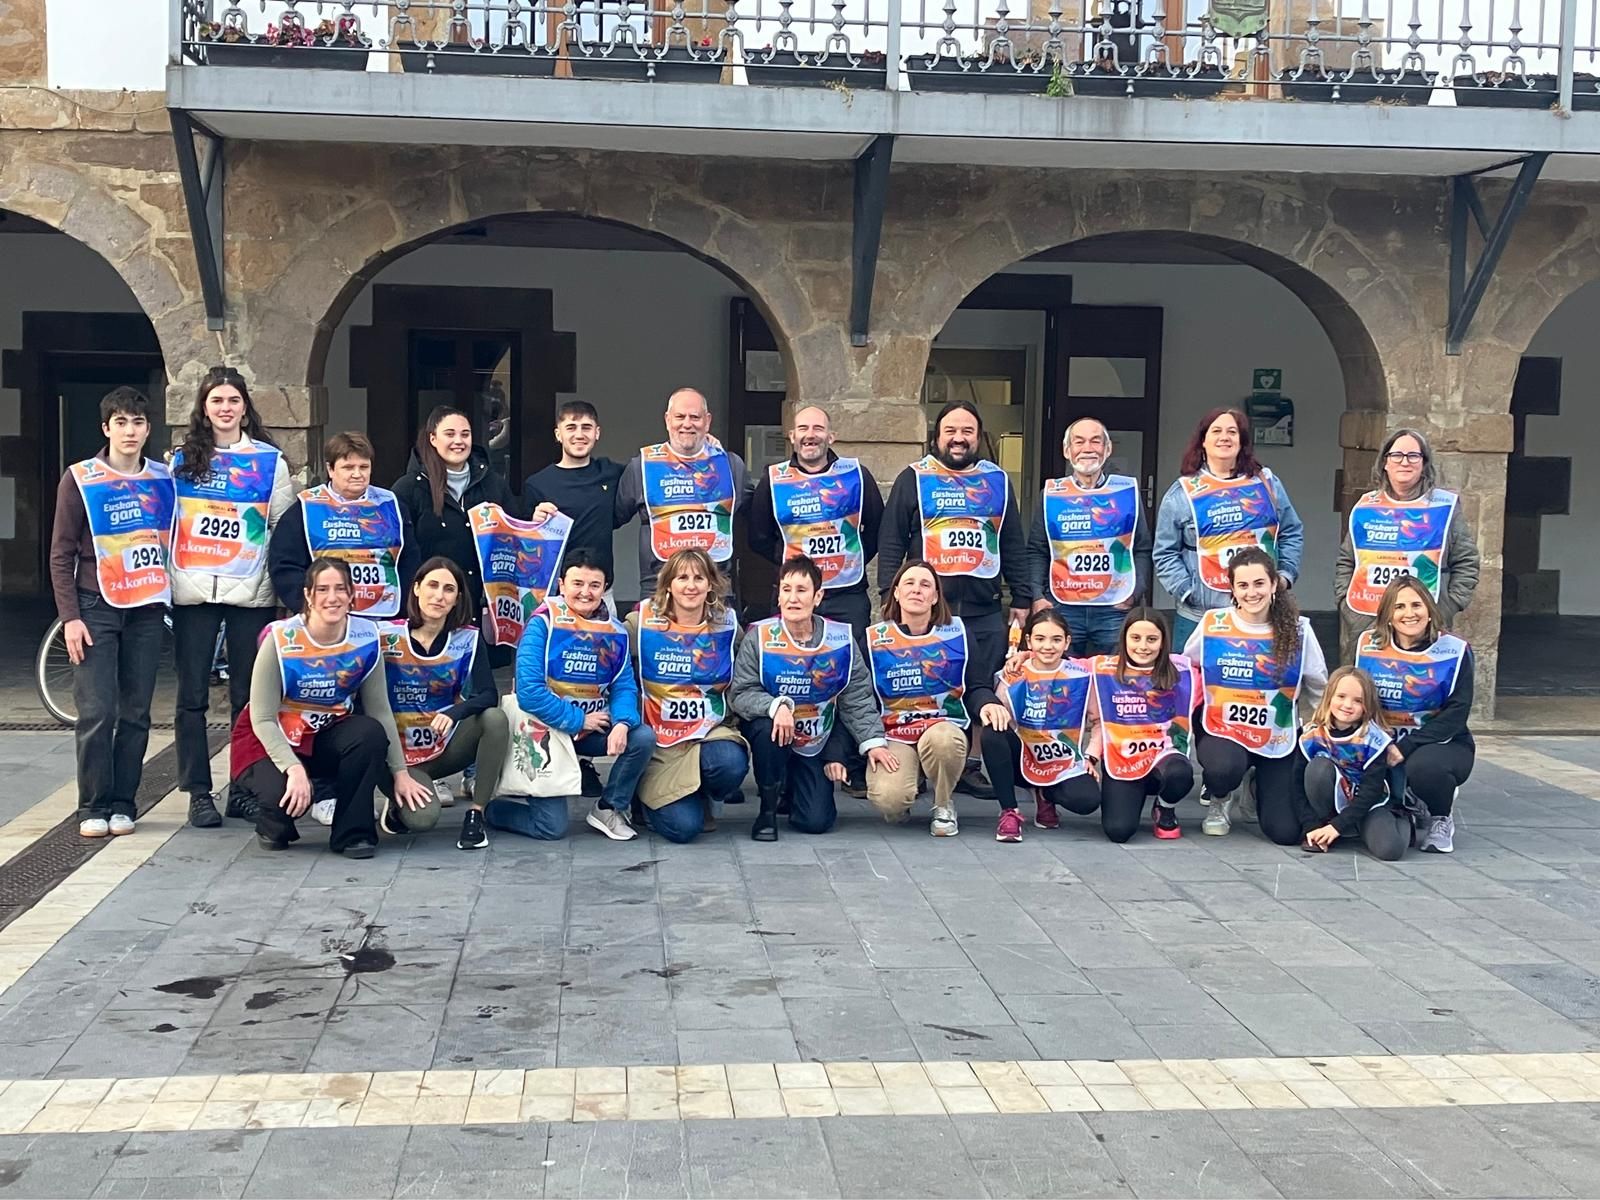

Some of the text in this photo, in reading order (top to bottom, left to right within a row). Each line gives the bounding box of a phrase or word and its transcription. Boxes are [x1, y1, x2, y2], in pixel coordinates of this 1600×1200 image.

[660, 478, 694, 487] Euskara
[664, 485, 694, 498] gara
[932, 491, 965, 499] Euskara
[103, 500, 140, 512] Euskara
[787, 496, 820, 507] Euskara
[936, 497, 966, 510] gara
[110, 508, 142, 525] gara
[792, 504, 821, 517] gara
[1057, 513, 1091, 521] Euskara
[1207, 506, 1241, 517] Euskara
[322, 520, 359, 529] Euskara
[678, 514, 712, 531] 2927
[1061, 520, 1091, 533] gara
[1213, 513, 1243, 527] gara
[1363, 522, 1399, 531] Euskara
[200, 517, 240, 539] 2929
[328, 528, 361, 541] gara
[949, 531, 983, 549] 2932
[1366, 530, 1398, 542] gara
[809, 536, 841, 555] 2927
[492, 561, 516, 574] gara
[1074, 554, 1110, 572] 2928
[352, 566, 380, 584] 933
[562, 650, 598, 661] Euskara
[654, 652, 691, 662] Euskara
[564, 659, 597, 673] gara
[658, 661, 691, 674] gara
[1217, 658, 1253, 668] Euskara
[886, 667, 921, 678] Euskara
[1222, 666, 1253, 679] gara
[296, 679, 336, 688] Euskara
[775, 675, 811, 684] Euskara
[892, 676, 922, 691] gara
[300, 687, 336, 698] gara
[779, 684, 811, 695] gara
[1377, 687, 1402, 699] ara
[1112, 695, 1146, 704] Euskara
[669, 701, 706, 719] 2931
[1116, 703, 1147, 717] gara
[1229, 705, 1268, 726] 2926
[795, 719, 819, 736] 931
[1034, 743, 1072, 761] 2934
